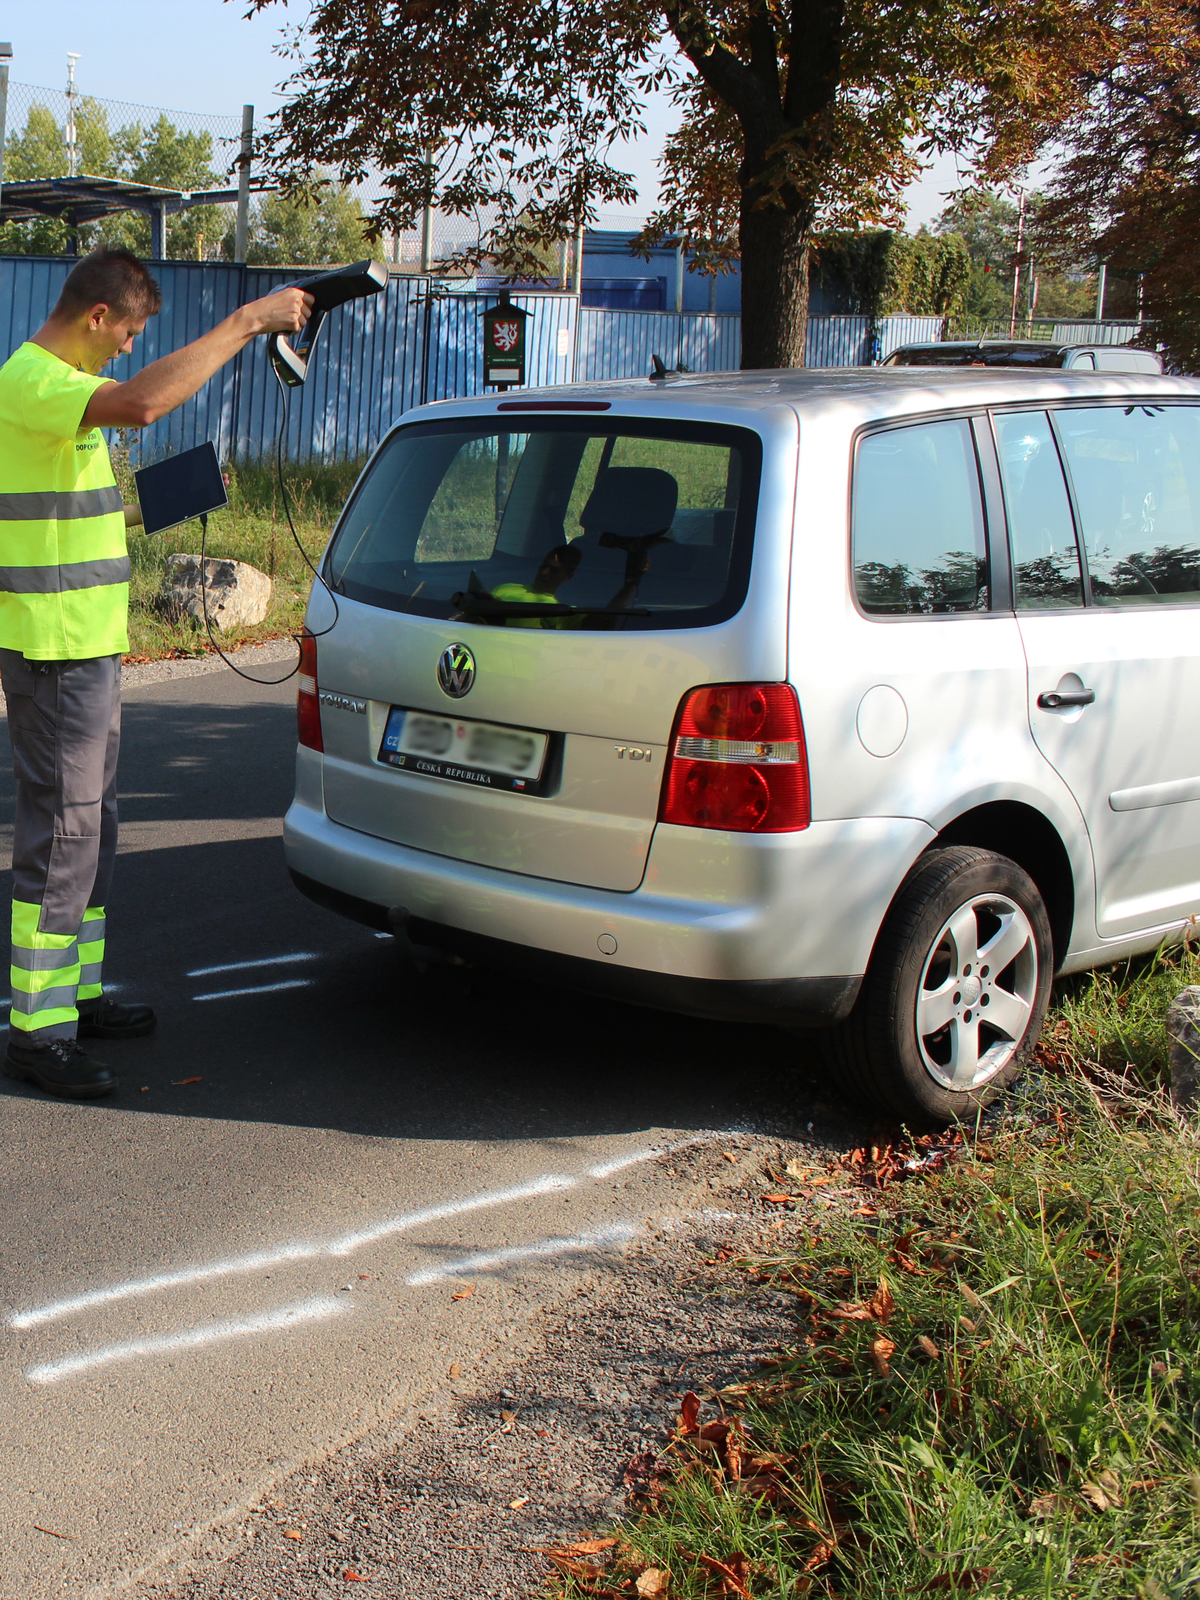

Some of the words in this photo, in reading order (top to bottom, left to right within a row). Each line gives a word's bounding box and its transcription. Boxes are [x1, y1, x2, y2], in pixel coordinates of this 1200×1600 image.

[319, 693, 367, 715] TOURAN
[386, 735, 399, 747] CZ
[614, 744, 653, 763] TDI
[416, 761, 441, 774] ČESKÁ
[445, 767, 491, 784] REPUBLIKA
